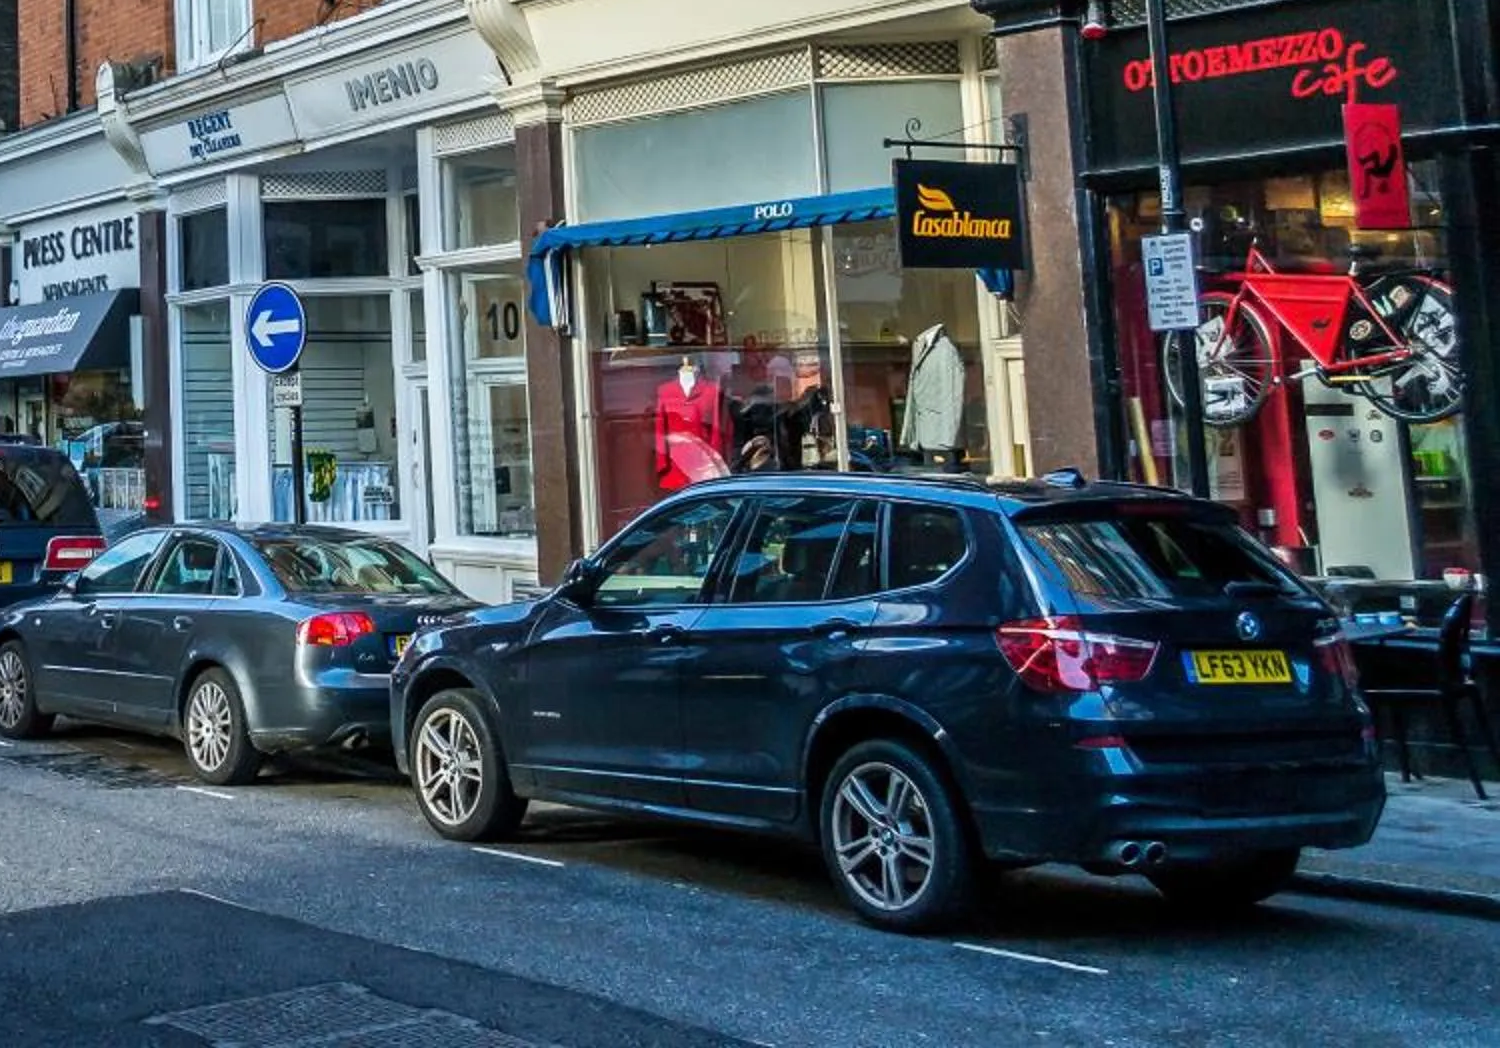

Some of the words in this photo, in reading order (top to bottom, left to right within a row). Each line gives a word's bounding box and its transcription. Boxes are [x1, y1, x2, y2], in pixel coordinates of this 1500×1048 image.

[344, 57, 439, 112] IMENIO
[1292, 42, 1397, 106] cafe
[754, 201, 794, 220] POLO
[912, 210, 1012, 239] Casablanca
[23, 231, 65, 270] PRESS
[71, 216, 134, 260] CENTRE
[487, 301, 520, 341] 10
[1196, 654, 1247, 679] LF63
[1246, 653, 1287, 677] YKN
